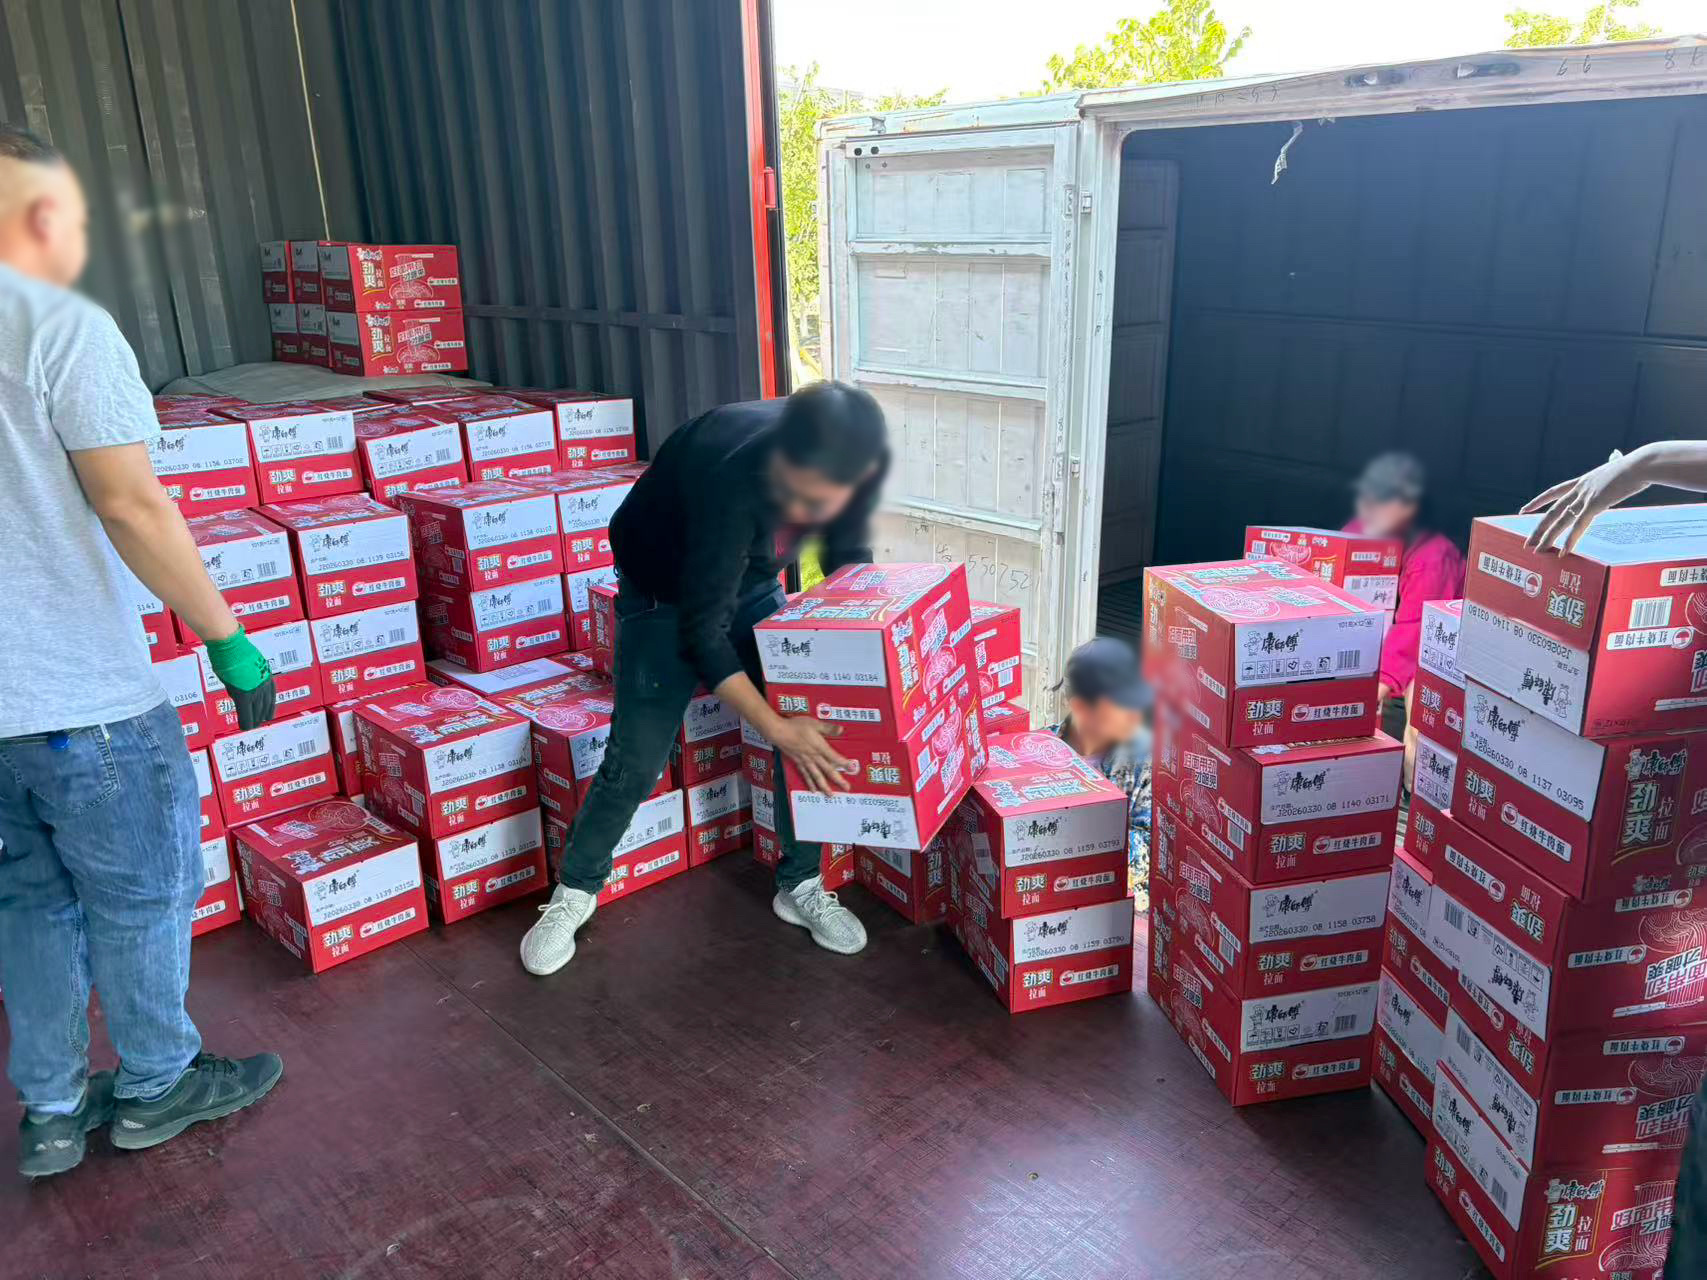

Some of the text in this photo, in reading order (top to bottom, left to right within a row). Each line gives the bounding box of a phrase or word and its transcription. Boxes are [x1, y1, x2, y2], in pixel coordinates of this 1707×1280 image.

[270, 470, 296, 484] 劲爽
[571, 539, 594, 553] 劲爽
[478, 555, 501, 571] 劲爽
[1482, 554, 1522, 585] 红烧牛肉面
[318, 581, 346, 597] 劲爽
[1559, 568, 1582, 594] 拉面
[325, 597, 342, 608] 拉面
[1546, 588, 1586, 628] 劲爽
[1513, 625, 1524, 638] 08
[1613, 631, 1668, 646] 红烧牛肉面
[487, 636, 510, 651] 劲爽
[331, 667, 358, 684] 劲爽
[338, 683, 354, 694] 拉面
[777, 694, 809, 714] 劲爽
[1419, 684, 1443, 713] 劲爽
[1247, 699, 1284, 720] 劲爽
[1312, 704, 1360, 720] 红烧牛肉面
[1422, 708, 1436, 729] 拉面
[1252, 721, 1274, 736] 拉面
[868, 764, 900, 784] 劲爽
[1518, 764, 1529, 779] 08
[1532, 773, 1553, 791] 1137
[234, 783, 263, 802] 劲爽
[1464, 767, 1496, 806] 劲爽
[242, 801, 260, 813] 拉面
[441, 796, 469, 816] 劲爽
[1326, 801, 1337, 811] 08
[1341, 798, 1361, 809] 1140
[1468, 799, 1488, 823] 拉面
[1622, 781, 1659, 844] 劲爽
[448, 815, 465, 826] 拉面
[1414, 811, 1435, 842] 劲爽
[1653, 797, 1674, 841] 拉面
[699, 827, 721, 844] 劲爽
[1270, 833, 1306, 854] 劲爽
[1332, 834, 1378, 851] 红烧牛肉面
[1520, 817, 1566, 857] 红烧牛肉面
[1415, 836, 1429, 855] 拉面
[1276, 854, 1297, 869] 拉面
[1449, 849, 1487, 883] 红烧牛肉面
[452, 879, 480, 899] 劲爽
[1016, 874, 1048, 893] 劲爽
[1072, 872, 1111, 889] 红烧牛肉面
[460, 898, 476, 910] 拉面
[1022, 892, 1040, 905] 拉面
[1520, 885, 1541, 911] 拉面
[1312, 921, 1324, 932] 08
[1510, 898, 1545, 944] 劲爽
[324, 925, 353, 946] 劲爽
[1388, 926, 1408, 956] 劲爽
[331, 945, 350, 958] 拉面
[1320, 952, 1364, 968] 红烧牛肉面
[1258, 951, 1294, 972] 劲爽
[1022, 969, 1054, 988] 劲爽
[1077, 965, 1116, 982] 红烧牛肉面
[1263, 972, 1284, 986] 拉面
[1028, 987, 1047, 1000] 拉面
[1507, 1032, 1535, 1077] 劲爽
[1250, 1061, 1286, 1080] 劲爽
[1311, 1060, 1356, 1076] 红烧牛肉面
[1256, 1080, 1277, 1094] 拉面
[1544, 1203, 1578, 1254] 劲爽
[1575, 1215, 1593, 1252] 拉面
